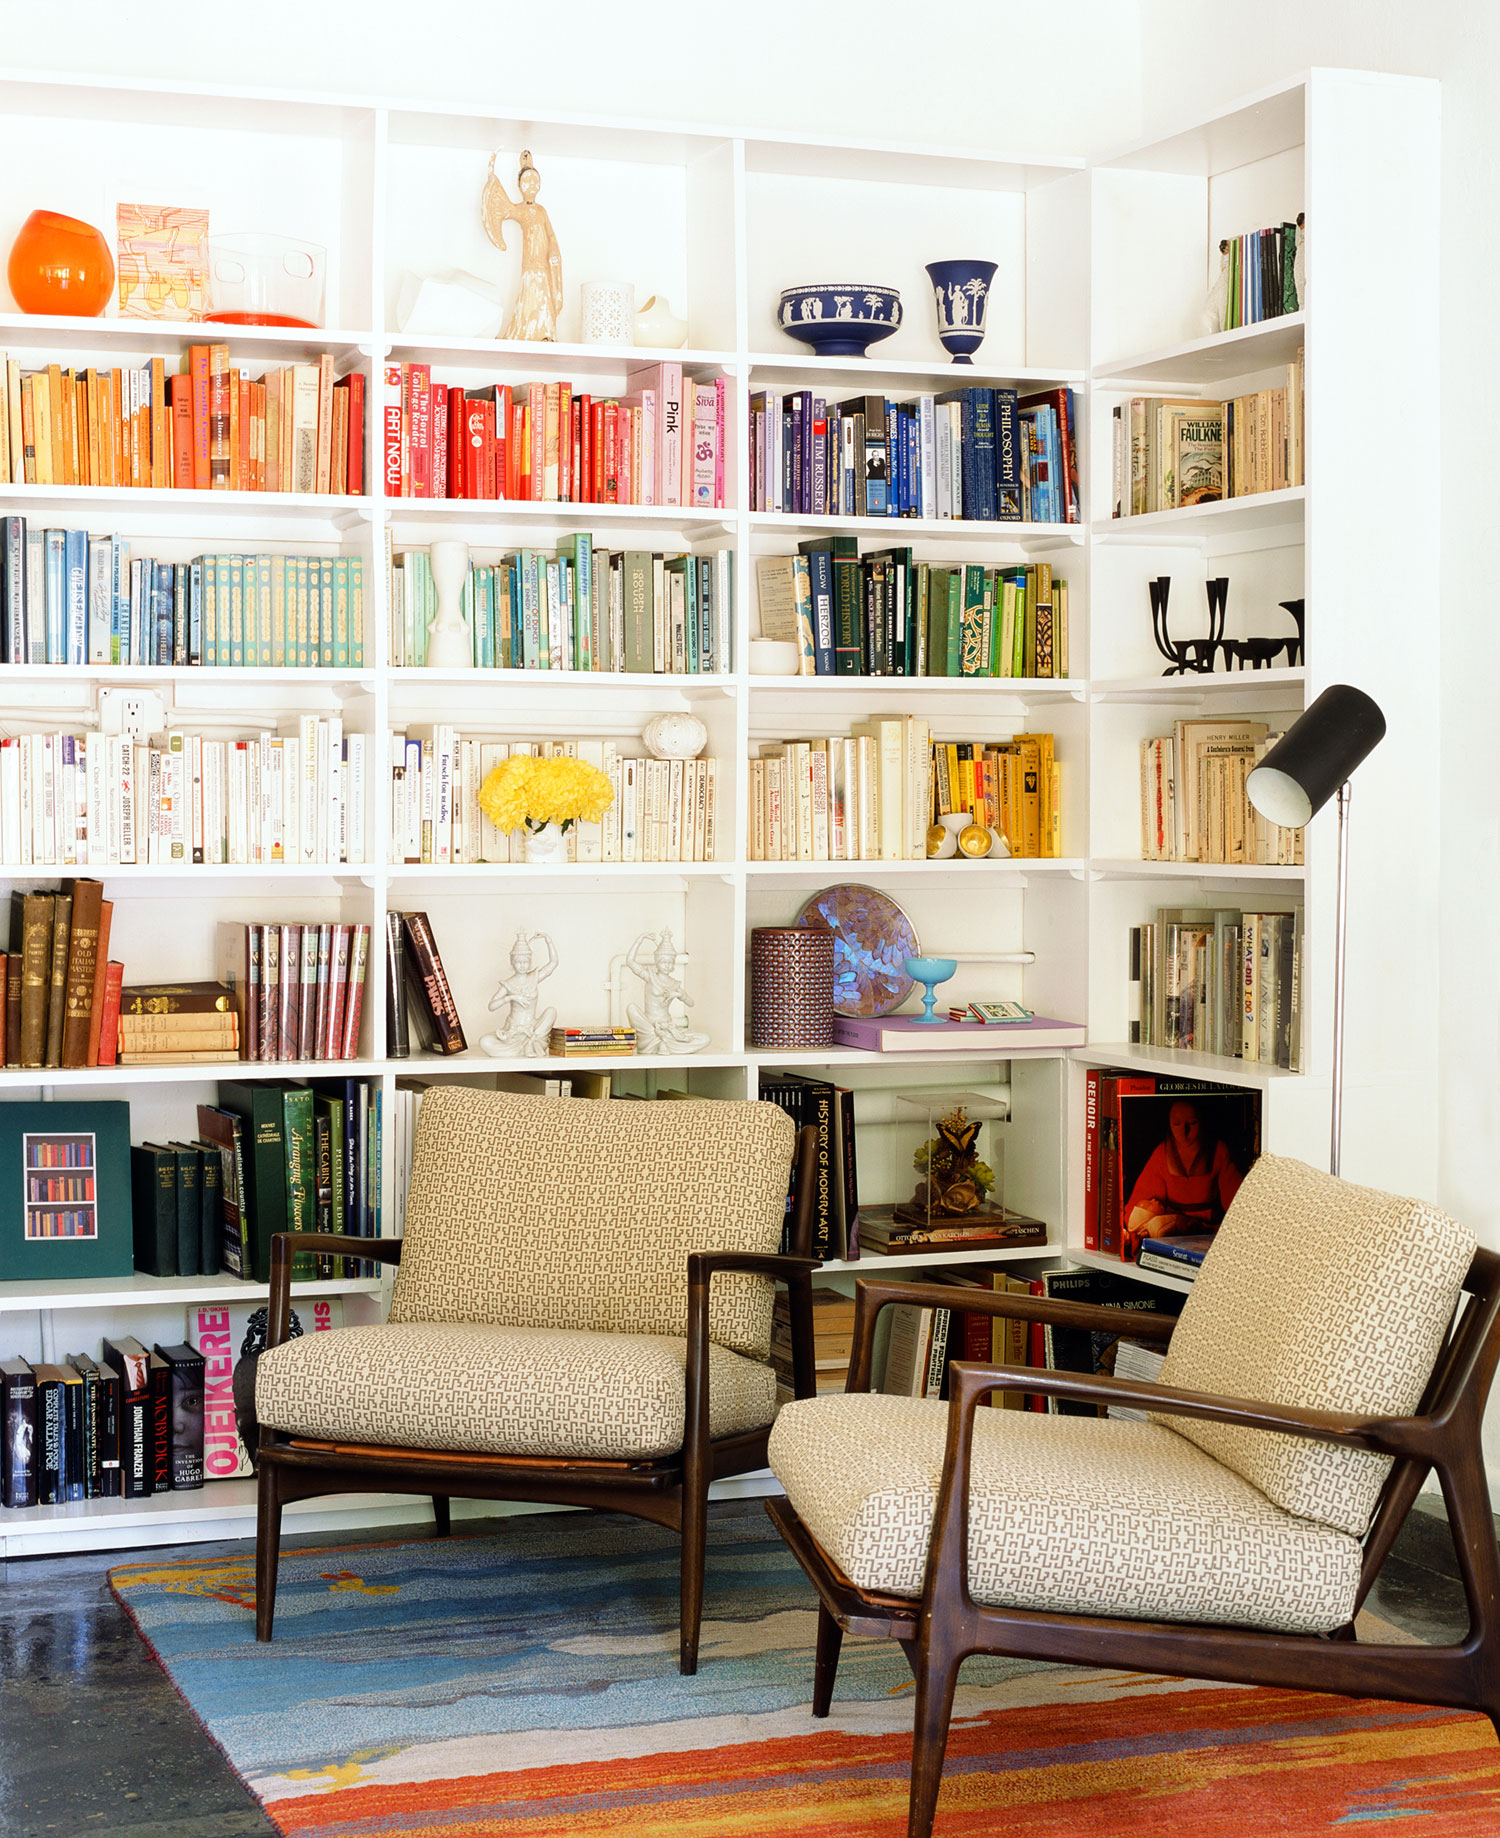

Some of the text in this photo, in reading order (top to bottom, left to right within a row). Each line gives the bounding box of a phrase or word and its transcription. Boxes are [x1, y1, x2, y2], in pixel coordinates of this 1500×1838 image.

[215, 352, 225, 388] Umberto
[215, 390, 225, 405] Eco
[412, 371, 421, 449] College Reader
[420, 392, 429, 412] The
[561, 389, 570, 412] THEM
[666, 401, 679, 433] Pink
[696, 396, 715, 407] Siva
[387, 408, 401, 485] ART NOW
[890, 409, 898, 440] ORANGES
[1001, 405, 1013, 482] PHILOSOPHY
[1181, 428, 1222, 442] FAULKNE
[815, 437, 825, 514] TIM RUSSERT
[818, 556, 827, 590] BELLOW
[121, 603, 130, 647] CHANDLER
[820, 597, 830, 647] HERZOG
[840, 564, 852, 647] WORLD HISTORY
[121, 744, 131, 776] CATCH-22
[121, 795, 132, 847] JOSEPH HELLER
[1086, 1080, 1097, 1130] RENOIR
[289, 1127, 306, 1231] Arranging Flowers
[320, 1130, 330, 1185] THE CABIN
[818, 1099, 829, 1241] HISTORY OF MODERN ART
[1052, 1279, 1091, 1290] PHILIPS
[1123, 1300, 1156, 1310] SIMONE
[940, 1309, 949, 1343] AFRICAN
[197, 1311, 239, 1476] OJEIKERE
[133, 1405, 144, 1478] JONATHAN FRANZEN
[154, 1396, 168, 1482] MOBY-DICK
